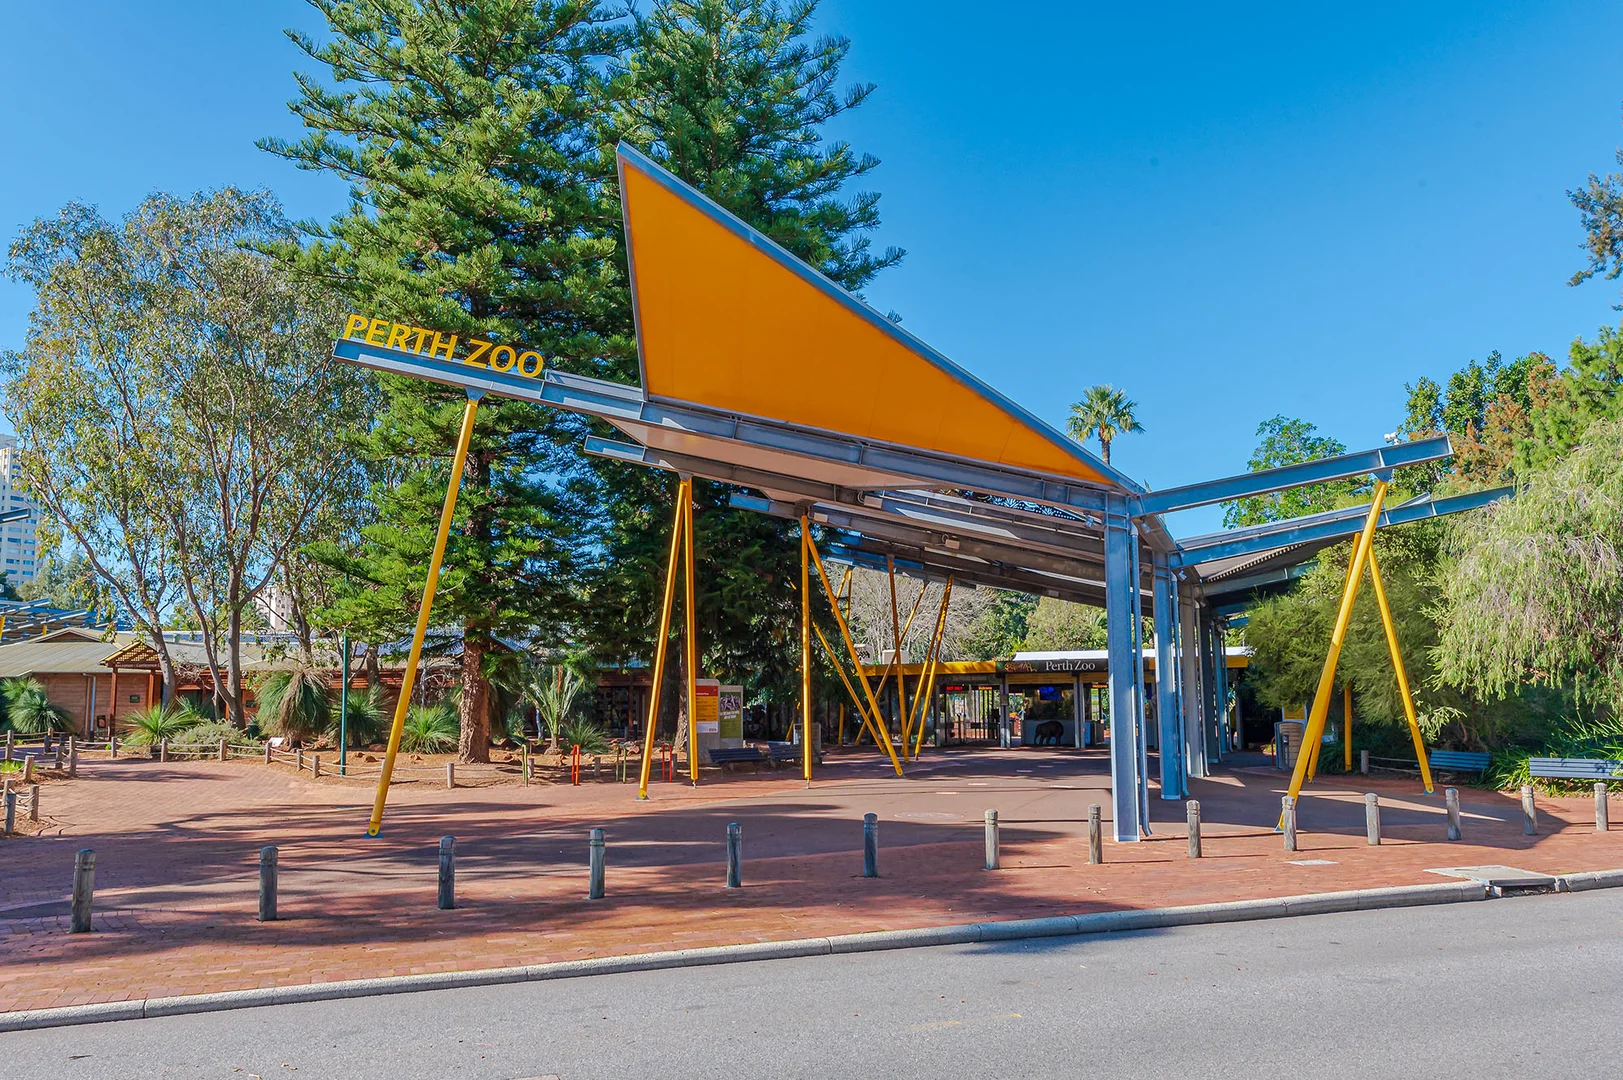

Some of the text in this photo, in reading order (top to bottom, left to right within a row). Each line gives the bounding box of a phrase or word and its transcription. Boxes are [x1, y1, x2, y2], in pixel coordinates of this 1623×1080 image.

[343, 314, 544, 377] PERTH ZOO
[1045, 660, 1096, 671] Perth Zoo
